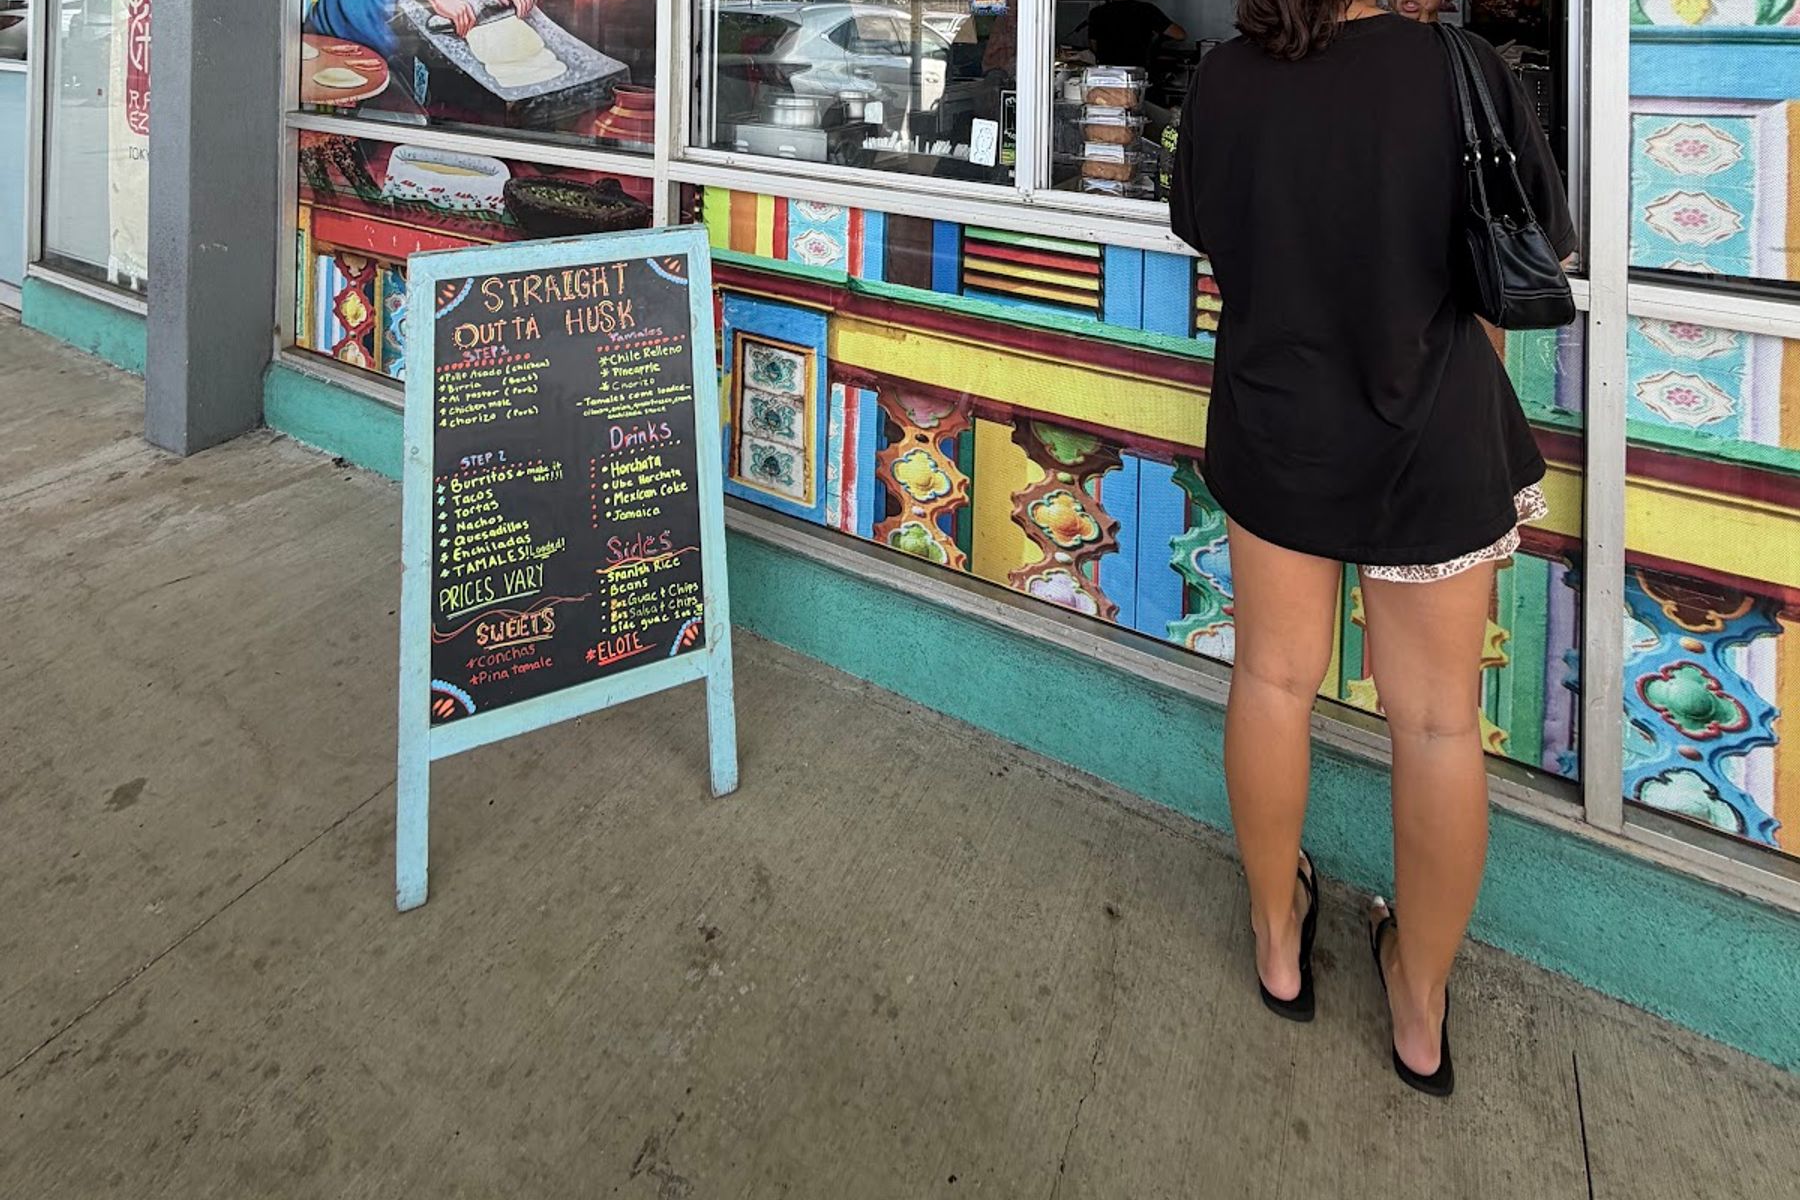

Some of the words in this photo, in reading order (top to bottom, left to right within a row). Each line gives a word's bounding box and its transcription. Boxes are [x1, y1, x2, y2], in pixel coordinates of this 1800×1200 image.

[481, 263, 628, 313] STRAIGHT
[453, 314, 541, 349] OUTTA
[565, 299, 635, 335] HUSK
[463, 345, 498, 362] STEP
[610, 350, 641, 365] Chile
[643, 345, 682, 358] Relleno
[610, 420, 671, 450] Drinks
[460, 451, 493, 470] STEP
[498, 450, 507, 462] 2
[610, 454, 662, 478] Horchata
[450, 469, 514, 493] Burritos
[611, 479, 634, 490] Ube
[638, 468, 682, 485] Horchata
[452, 488, 494, 506] Tacos
[613, 488, 658, 506] Mexican
[660, 480, 688, 496] Coke
[454, 500, 499, 518] Tortas
[612, 503, 660, 521] Jamaica
[454, 520, 529, 546] Quesadillas
[456, 514, 503, 533] Nachos
[453, 534, 531, 561] Enchiladas
[606, 530, 673, 563] Sides
[653, 557, 681, 572] Rice
[439, 576, 495, 612] PRICES
[504, 563, 544, 595] VARY
[610, 578, 648, 597] Beans
[628, 592, 658, 606] Guac
[668, 582, 699, 597] Chips
[629, 603, 658, 619] Salsa
[668, 595, 698, 610] Chips
[476, 607, 555, 645] SWEETS
[597, 631, 643, 661] ELOTE
[512, 656, 553, 674] tamale
